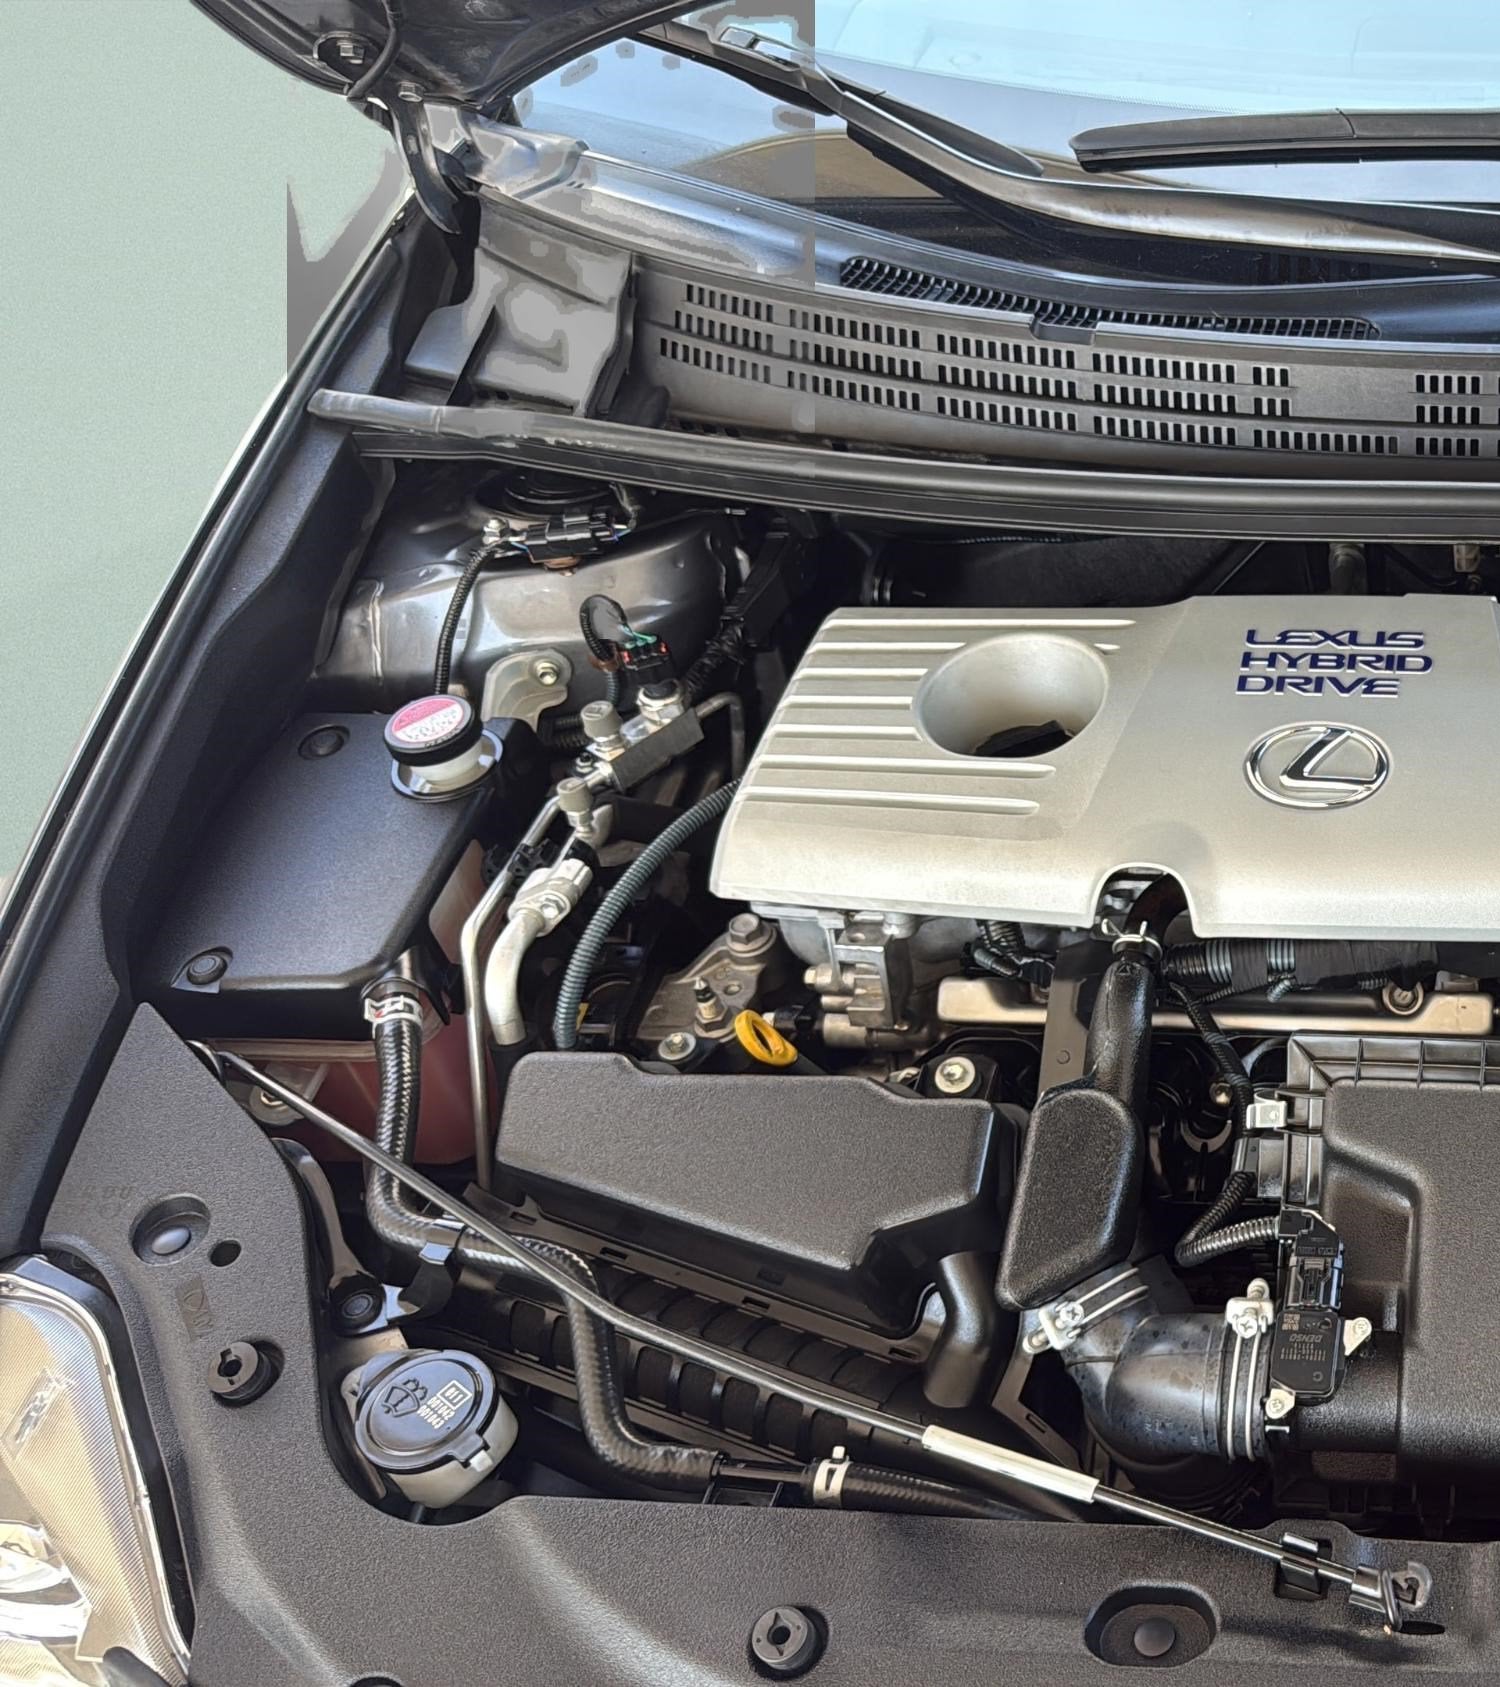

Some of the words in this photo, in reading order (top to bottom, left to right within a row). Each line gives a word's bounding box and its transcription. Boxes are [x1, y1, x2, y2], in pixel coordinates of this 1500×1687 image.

[1245, 629, 1425, 650] LEXUS
[1240, 651, 1433, 675] HYBRID
[1235, 675, 1400, 698] DRIVE
[1289, 1333, 1324, 1343] DENSO
